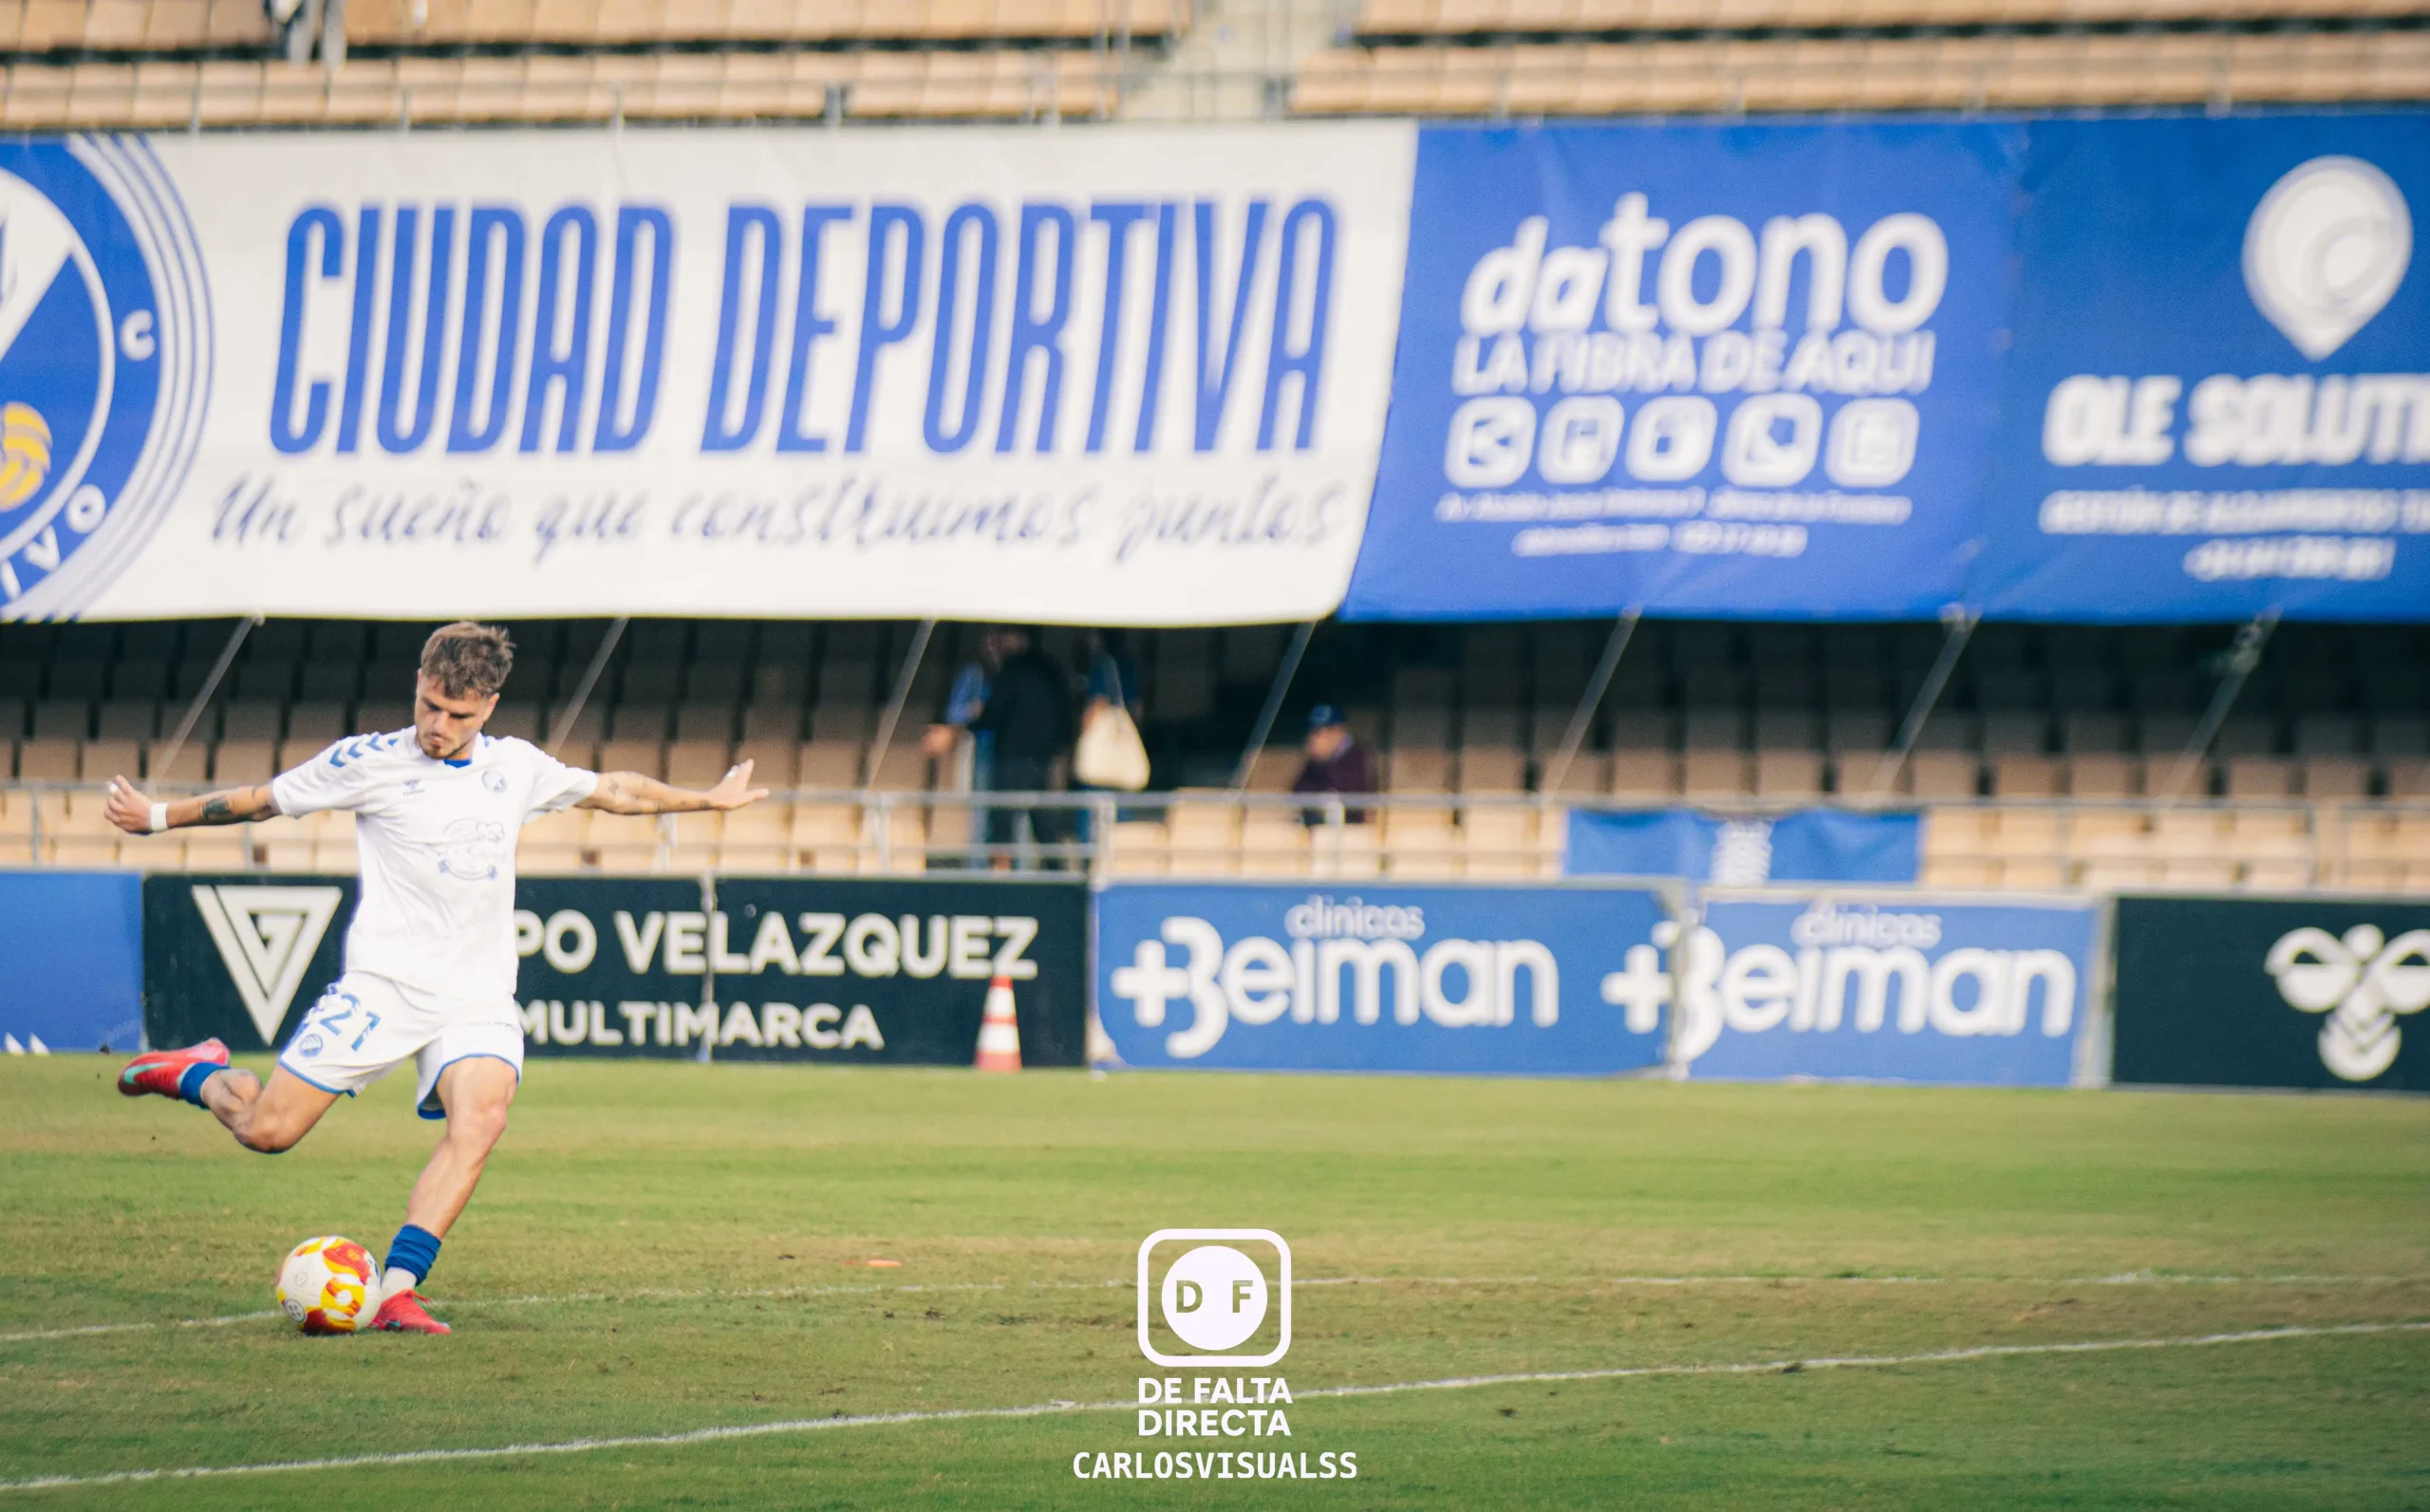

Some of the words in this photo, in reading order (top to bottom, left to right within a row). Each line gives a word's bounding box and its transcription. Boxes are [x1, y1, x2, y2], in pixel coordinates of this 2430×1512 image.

[1460, 192, 1949, 336] datono
[270, 202, 676, 456] CIUDAD
[699, 199, 1341, 454] DEPORTIVA
[1452, 332, 1528, 395] LA
[1699, 329, 1788, 394] DE
[2042, 374, 2181, 466] OLE
[211, 473, 301, 545] Un
[325, 474, 514, 547] sueño
[534, 489, 649, 569] que
[670, 475, 1103, 547] construimos
[1112, 473, 1352, 564] juntos
[613, 909, 1039, 980] VELAZQUEZ
[320, 993, 382, 1052] 21
[516, 999, 886, 1050] MULTIMARCA
